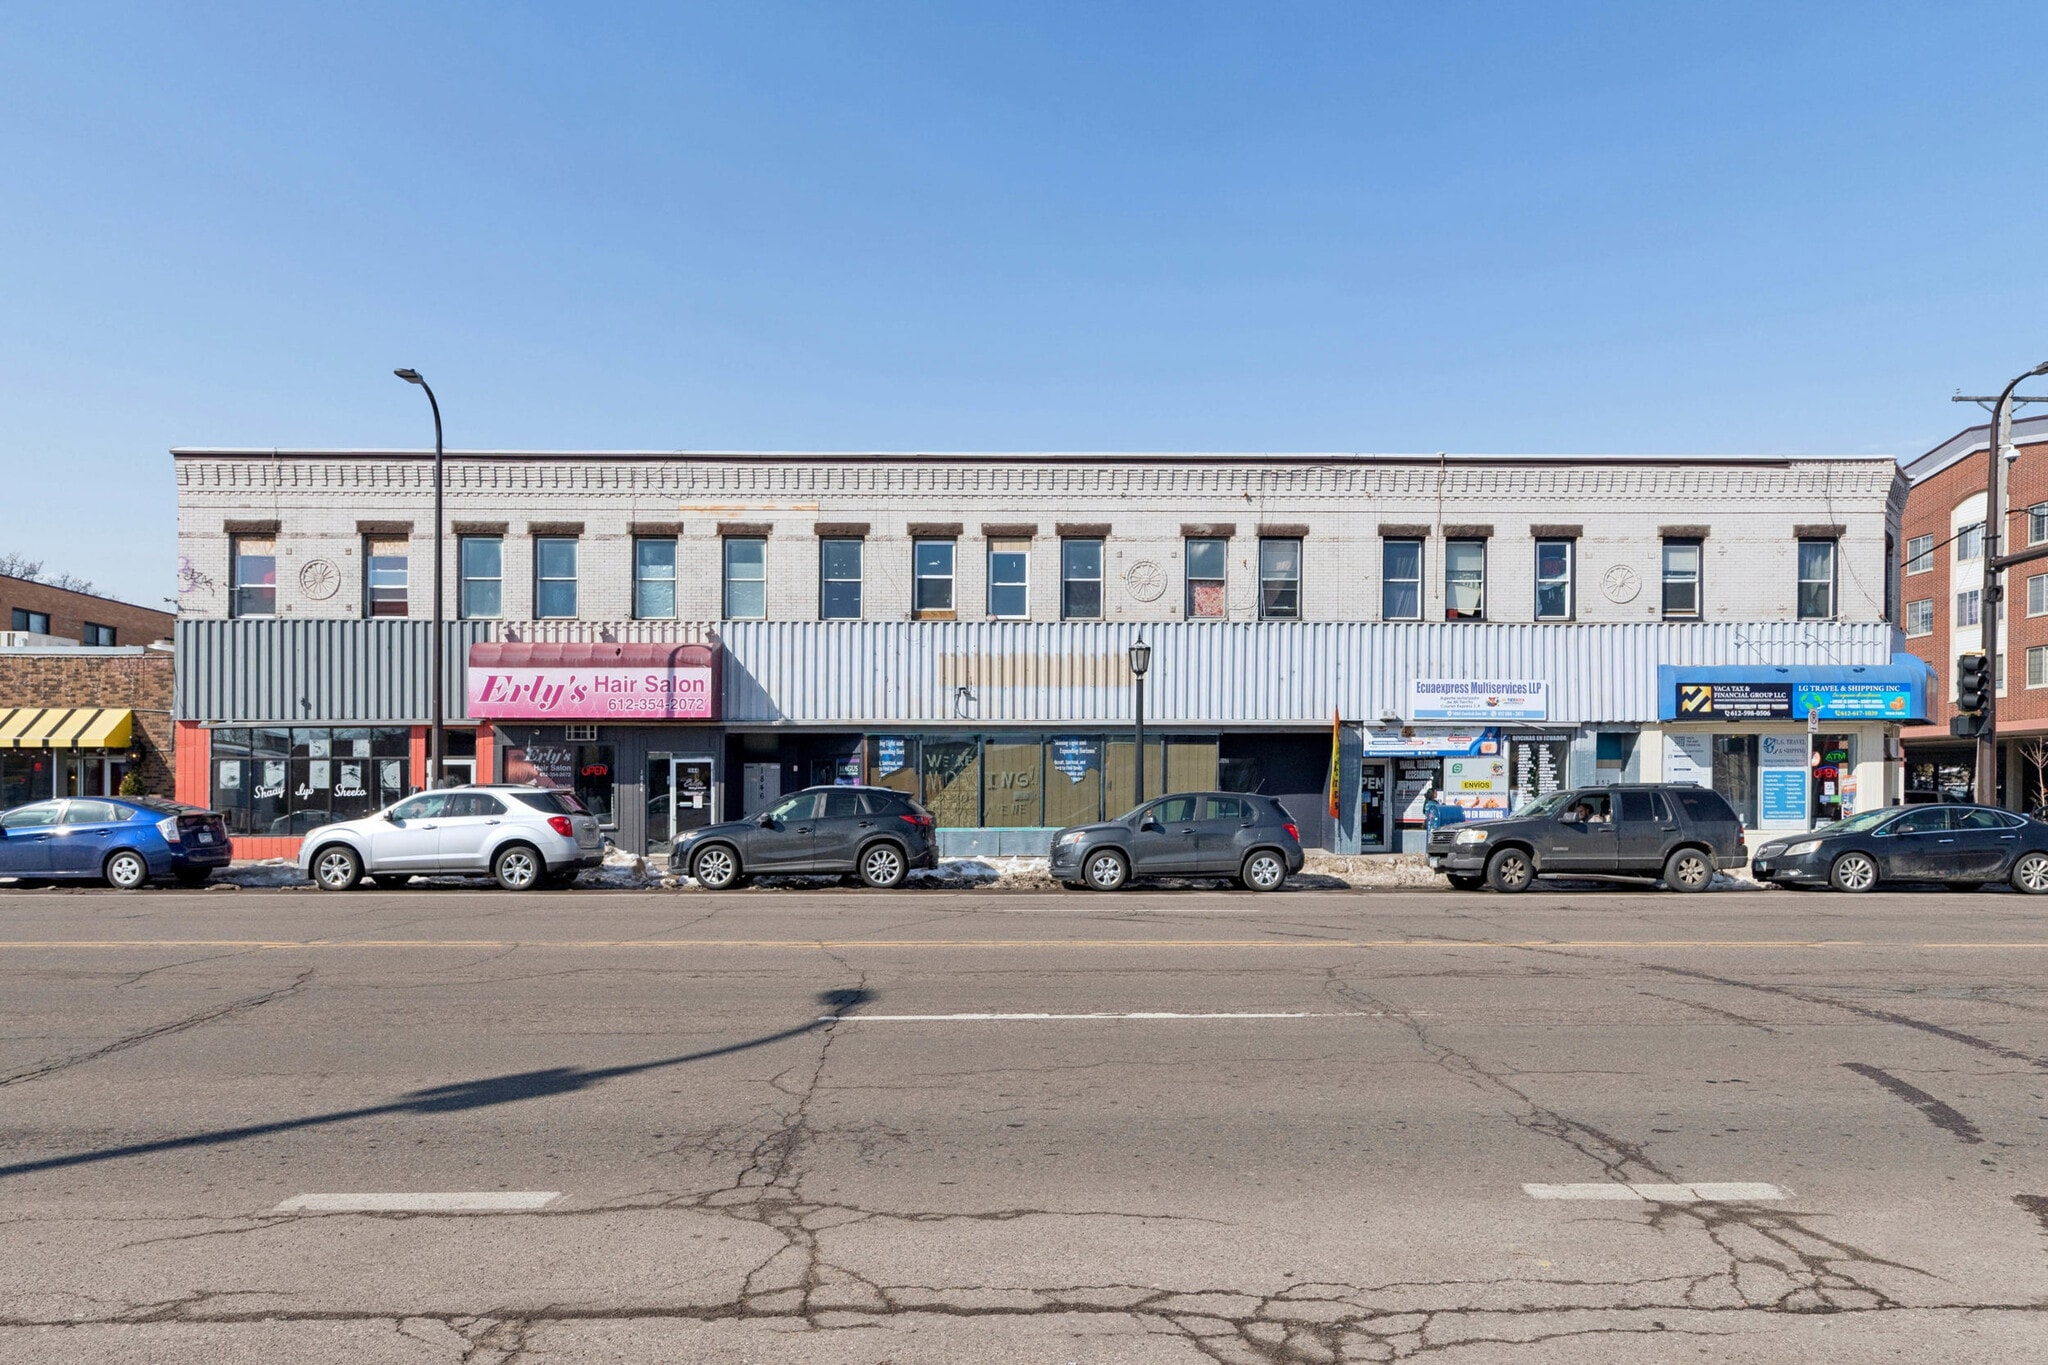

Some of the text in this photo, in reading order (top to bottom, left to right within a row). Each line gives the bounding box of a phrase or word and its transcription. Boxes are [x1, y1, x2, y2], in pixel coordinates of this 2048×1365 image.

[478, 674, 705, 710] Erly's Hair Salon
[1416, 682, 1541, 695] Ecuaexpress Multiservices LLP
[608, 698, 705, 710] 612-354-2072
[524, 748, 572, 764] Erly's
[1825, 752, 1846, 760] ATM
[581, 765, 608, 777] OPEN
[1813, 767, 1838, 779] OPEN
[1361, 777, 1384, 790] PEN
[334, 783, 367, 798] Sheeko
